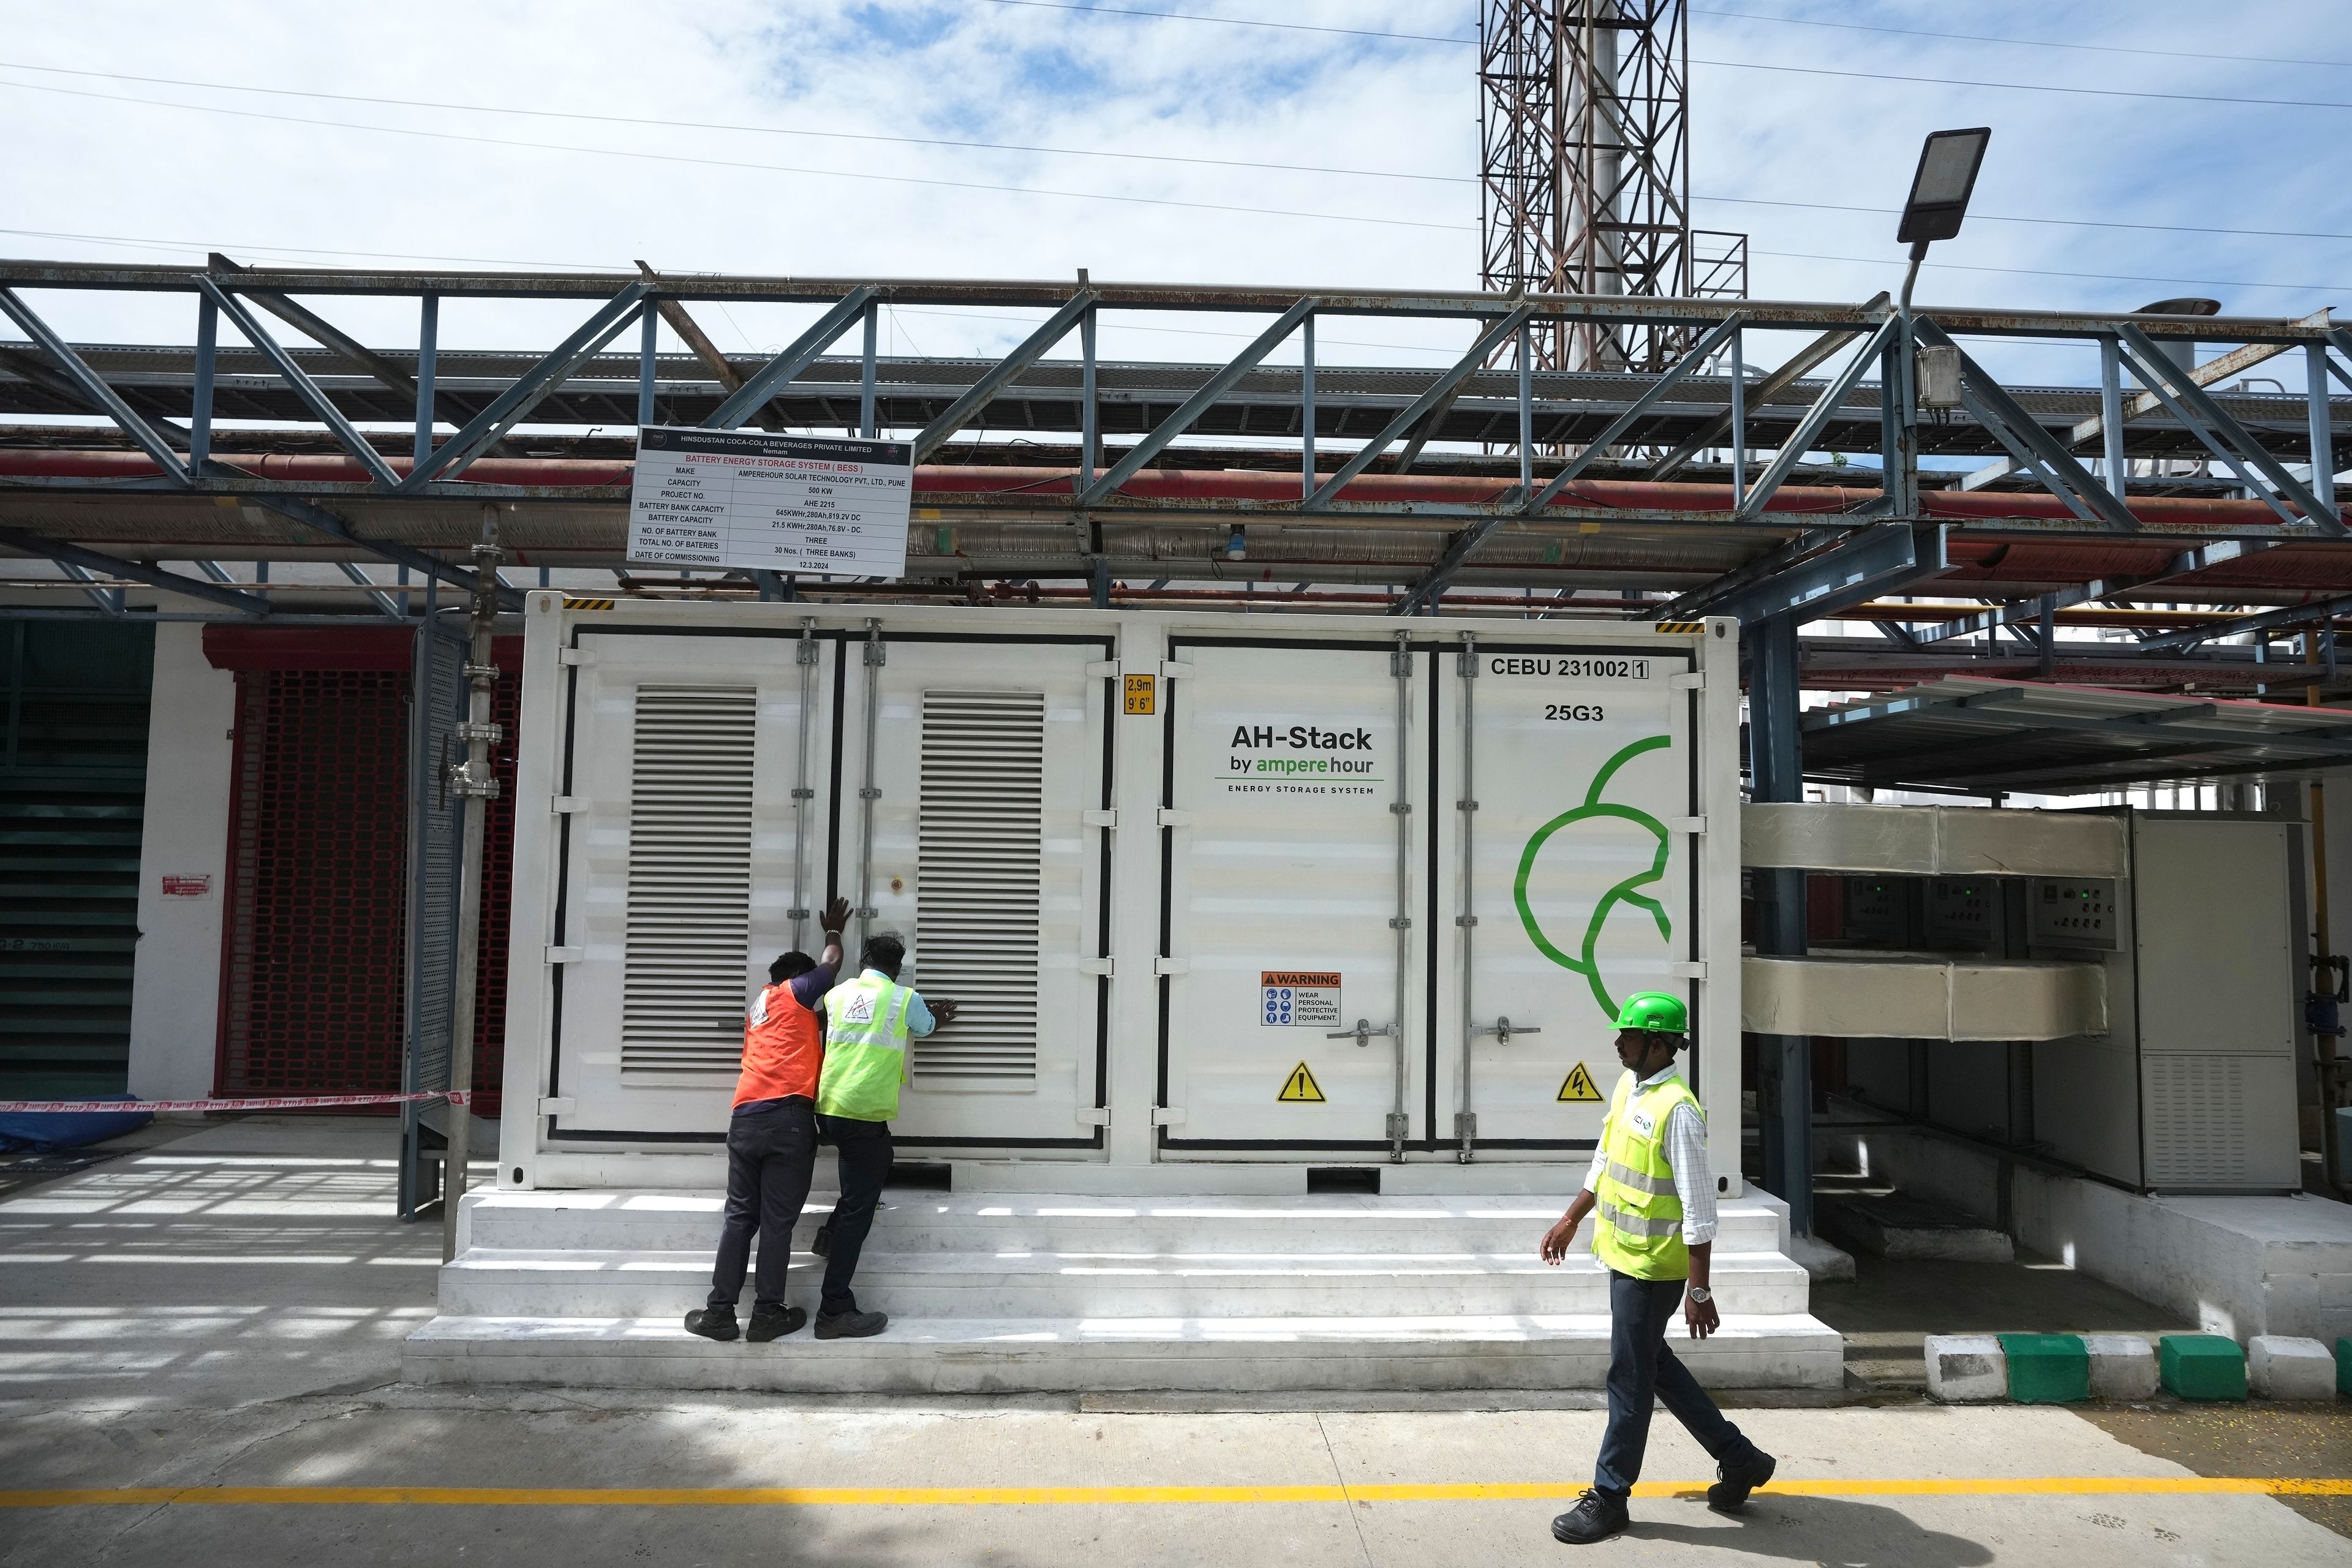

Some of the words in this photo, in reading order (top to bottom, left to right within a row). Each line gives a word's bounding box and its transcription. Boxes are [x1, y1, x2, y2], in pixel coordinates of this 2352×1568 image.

[758, 459, 795, 468] STORAGE
[738, 470, 783, 480] AMPEREHOUR
[686, 540, 718, 549] BATERIES
[665, 553, 719, 562] COMMISSIONING
[830, 550, 855, 559] BANKS)
[1491, 658, 1551, 675] CEBU
[1558, 660, 1628, 677] 231002
[1128, 679, 1151, 693] 2,9m
[1545, 705, 1604, 722] 25G3
[1231, 726, 1372, 750] AH-Stack
[1231, 756, 1251, 774] by
[1277, 974, 1338, 984] WARNING
